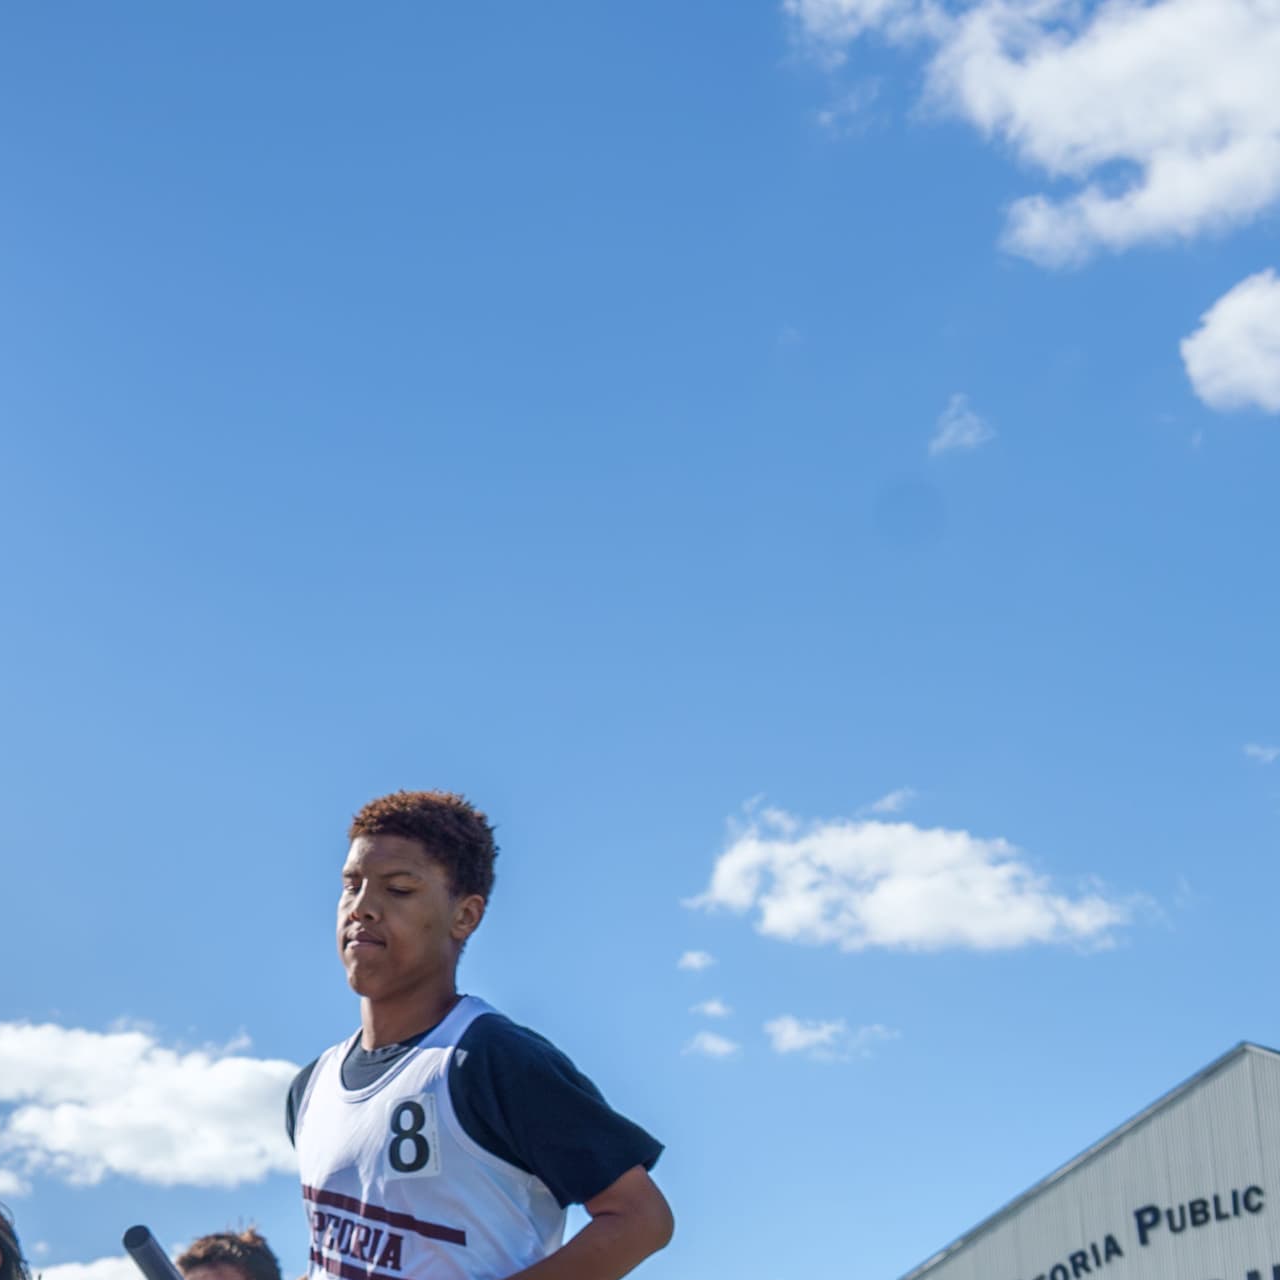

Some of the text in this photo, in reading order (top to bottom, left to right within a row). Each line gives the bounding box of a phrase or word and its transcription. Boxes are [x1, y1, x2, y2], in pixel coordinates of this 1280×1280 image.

[389, 1101, 430, 1173] 8
[313, 1211, 404, 1271] PEORIA
[1133, 1185, 1265, 1246] PUBLIC
